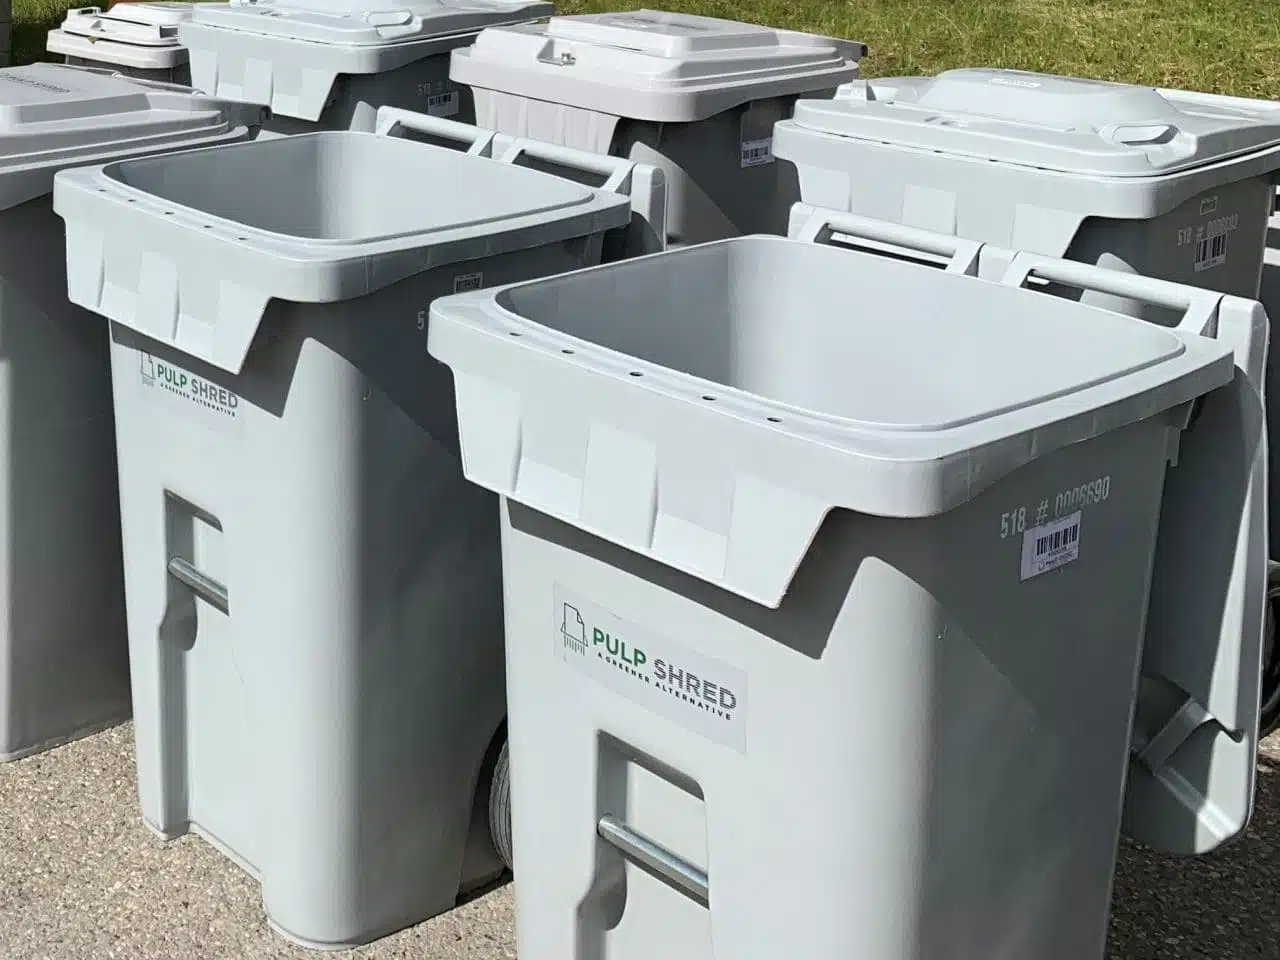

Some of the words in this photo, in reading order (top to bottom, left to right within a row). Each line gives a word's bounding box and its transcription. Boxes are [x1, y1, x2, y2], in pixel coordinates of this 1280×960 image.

[157, 364, 188, 388] PULP
[191, 378, 238, 408] SHRED
[165, 384, 190, 399] GREENER
[192, 396, 236, 418] ALTERNATIVE
[1000, 506, 1026, 539] 518
[1055, 475, 1111, 518] 0006690
[593, 627, 647, 667] PULP
[653, 658, 737, 710] SHRED
[597, 651, 603, 659] A
[606, 657, 650, 684] GREENER
[655, 681, 731, 720] ALTERNATIVE
